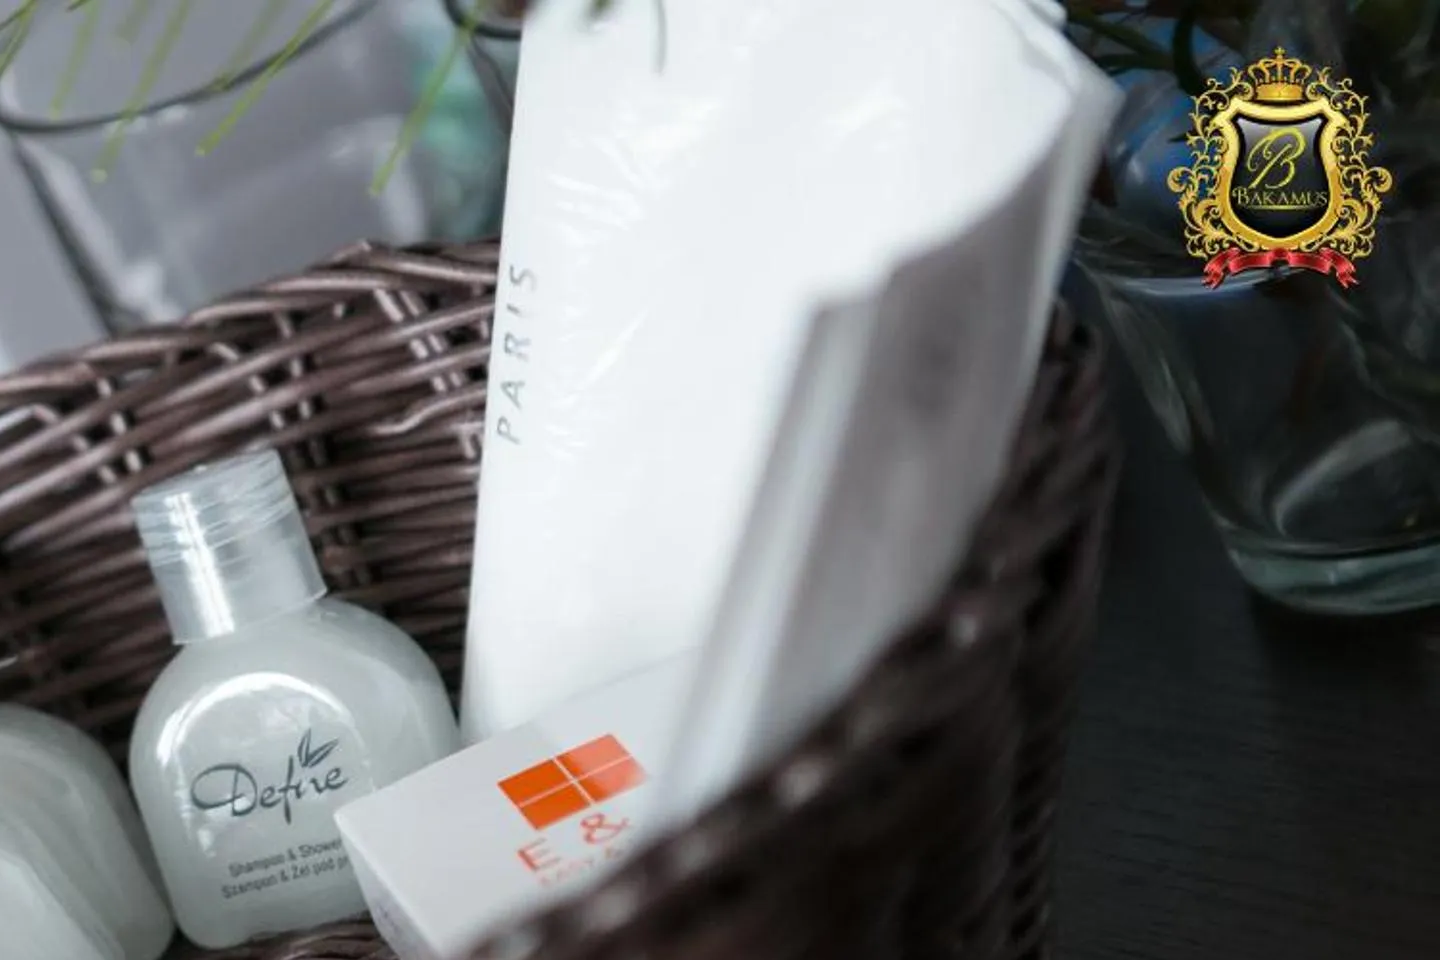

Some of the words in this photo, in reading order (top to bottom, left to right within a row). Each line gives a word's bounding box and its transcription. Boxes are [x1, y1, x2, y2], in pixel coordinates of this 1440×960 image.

[496, 264, 538, 446] PARIS
[190, 728, 348, 825] Define
[228, 853, 285, 878] Shampoo
